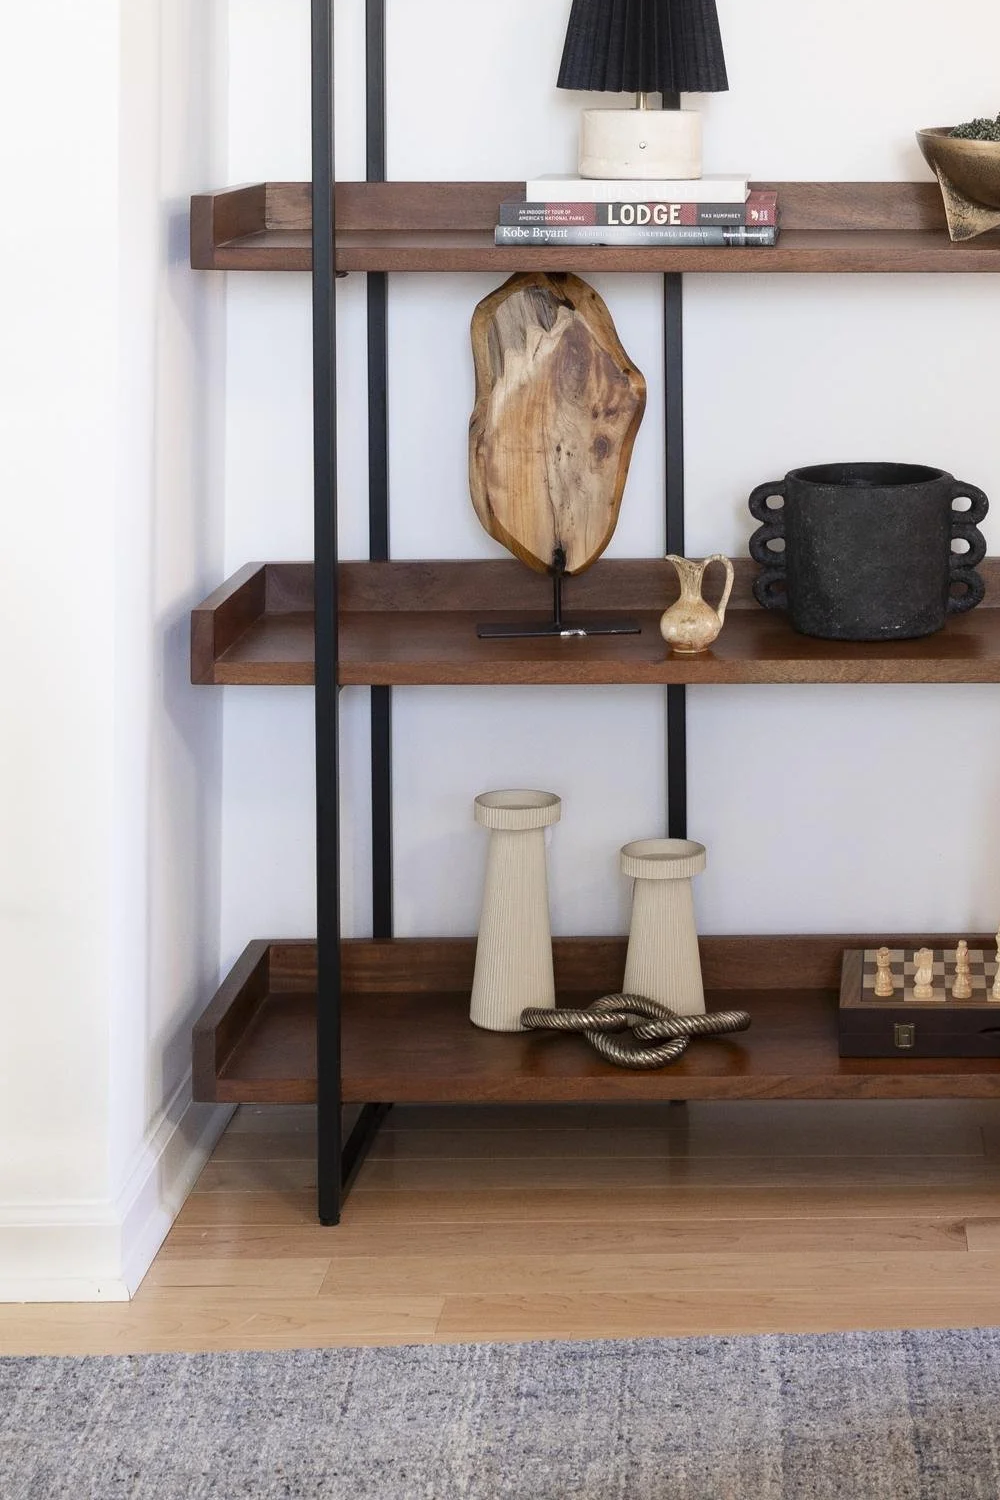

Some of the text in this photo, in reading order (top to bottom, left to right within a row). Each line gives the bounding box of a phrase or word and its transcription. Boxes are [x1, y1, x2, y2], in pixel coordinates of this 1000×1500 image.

[607, 204, 681, 225] LODGE
[503, 227, 568, 241] Kobe Bryant
